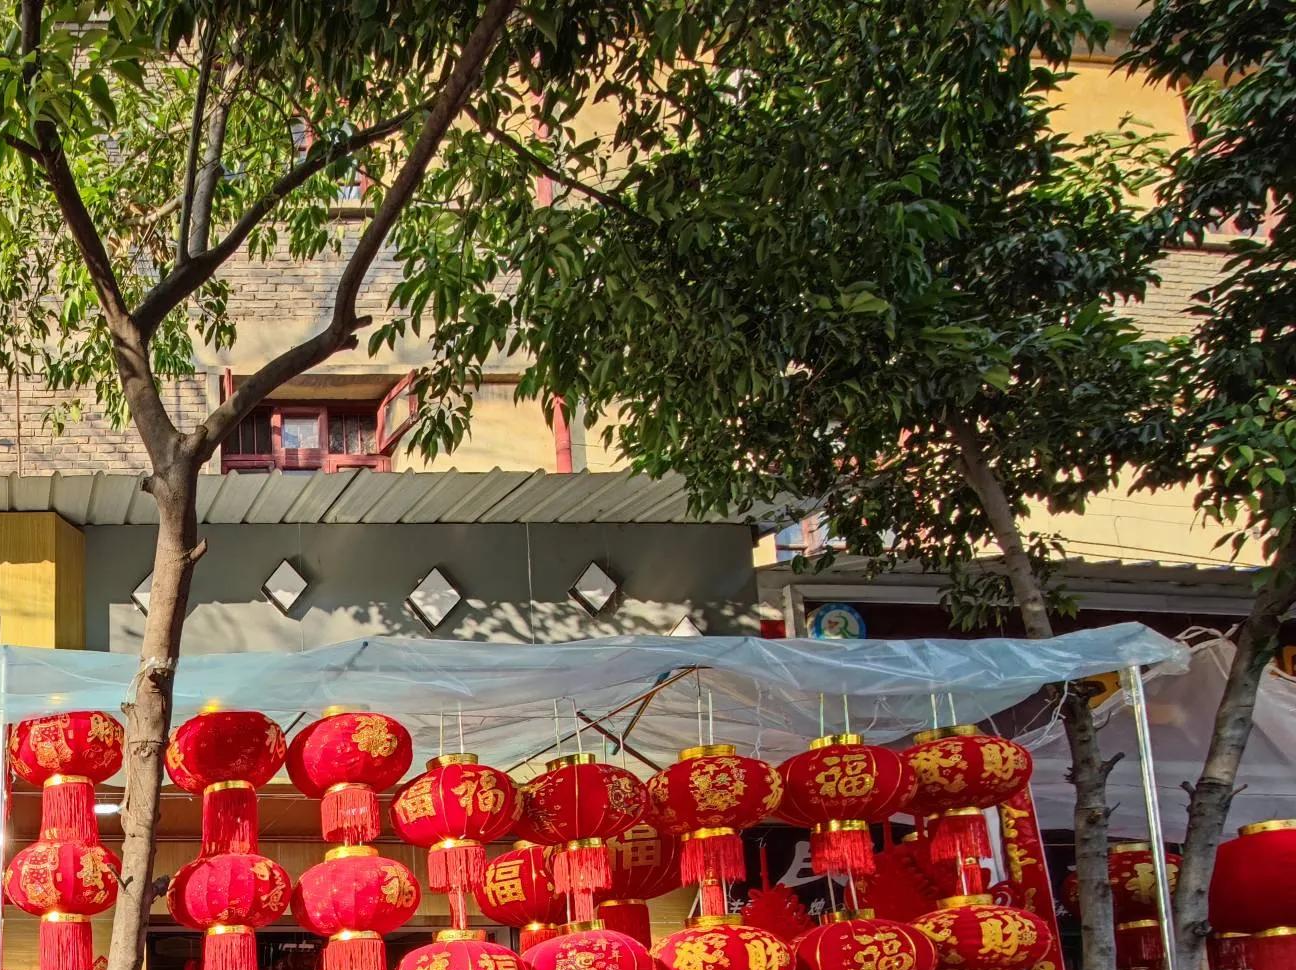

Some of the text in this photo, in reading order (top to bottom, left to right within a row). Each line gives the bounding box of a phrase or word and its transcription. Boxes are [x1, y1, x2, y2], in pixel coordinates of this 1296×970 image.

[451, 770, 505, 816] 福
[815, 753, 874, 798] 福
[485, 859, 527, 907] 福
